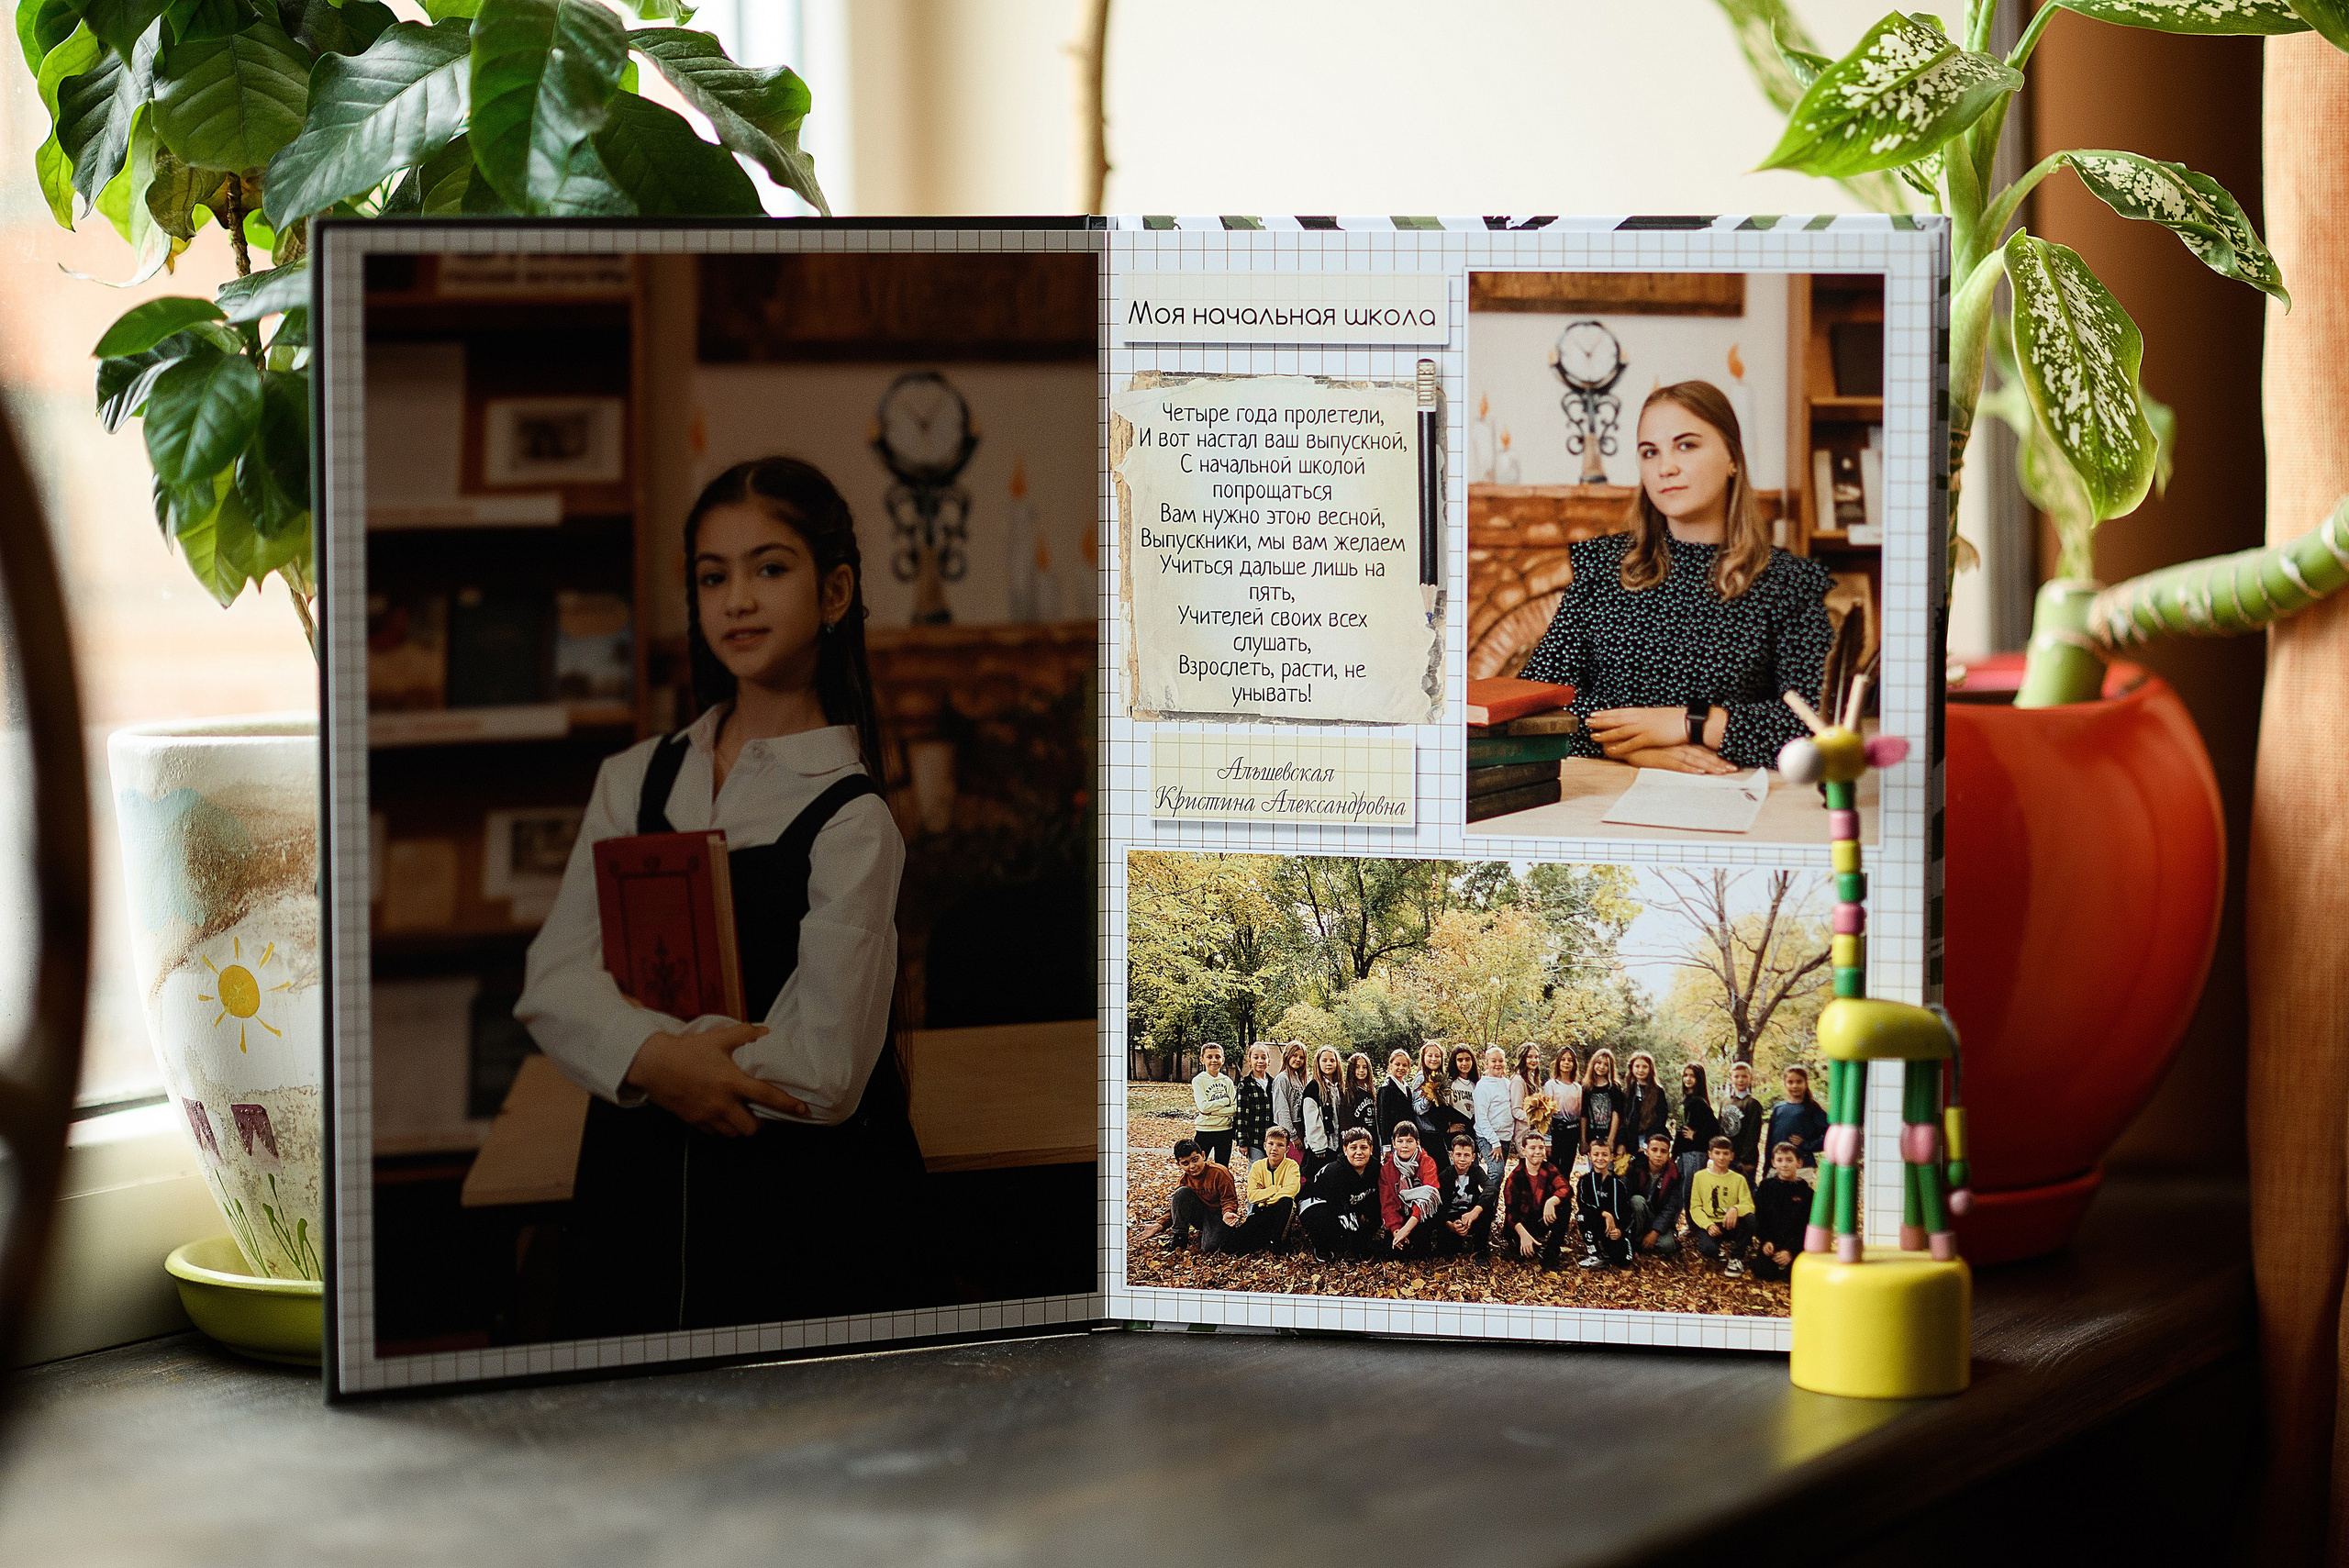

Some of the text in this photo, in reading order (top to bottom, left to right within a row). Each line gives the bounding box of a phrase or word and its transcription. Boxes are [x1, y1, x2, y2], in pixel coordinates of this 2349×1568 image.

[1128, 300, 1436, 327] Моя начальная школа
[1163, 402, 1385, 430] Четыре года пролетели,
[1140, 427, 1408, 456] И вот настал ваш выпускной,
[1180, 453, 1365, 476] С начальной школой
[1213, 484, 1332, 506] попрощаться
[1161, 502, 1386, 530] Вам нужно этою весной,
[1141, 527, 1406, 555] Выпускники, мы вам желаем
[1159, 553, 1386, 578] Учиться дальше лишь на
[1249, 585, 1296, 604] пять,
[1177, 605, 1368, 628] Учителей своих всех
[1233, 636, 1311, 658] слушать,
[1179, 654, 1367, 684] Взрослеть, расти, не
[1231, 683, 1311, 707] унывать!
[1217, 756, 1335, 783] Альшевская
[1154, 785, 1406, 823] Кристина Александровна
